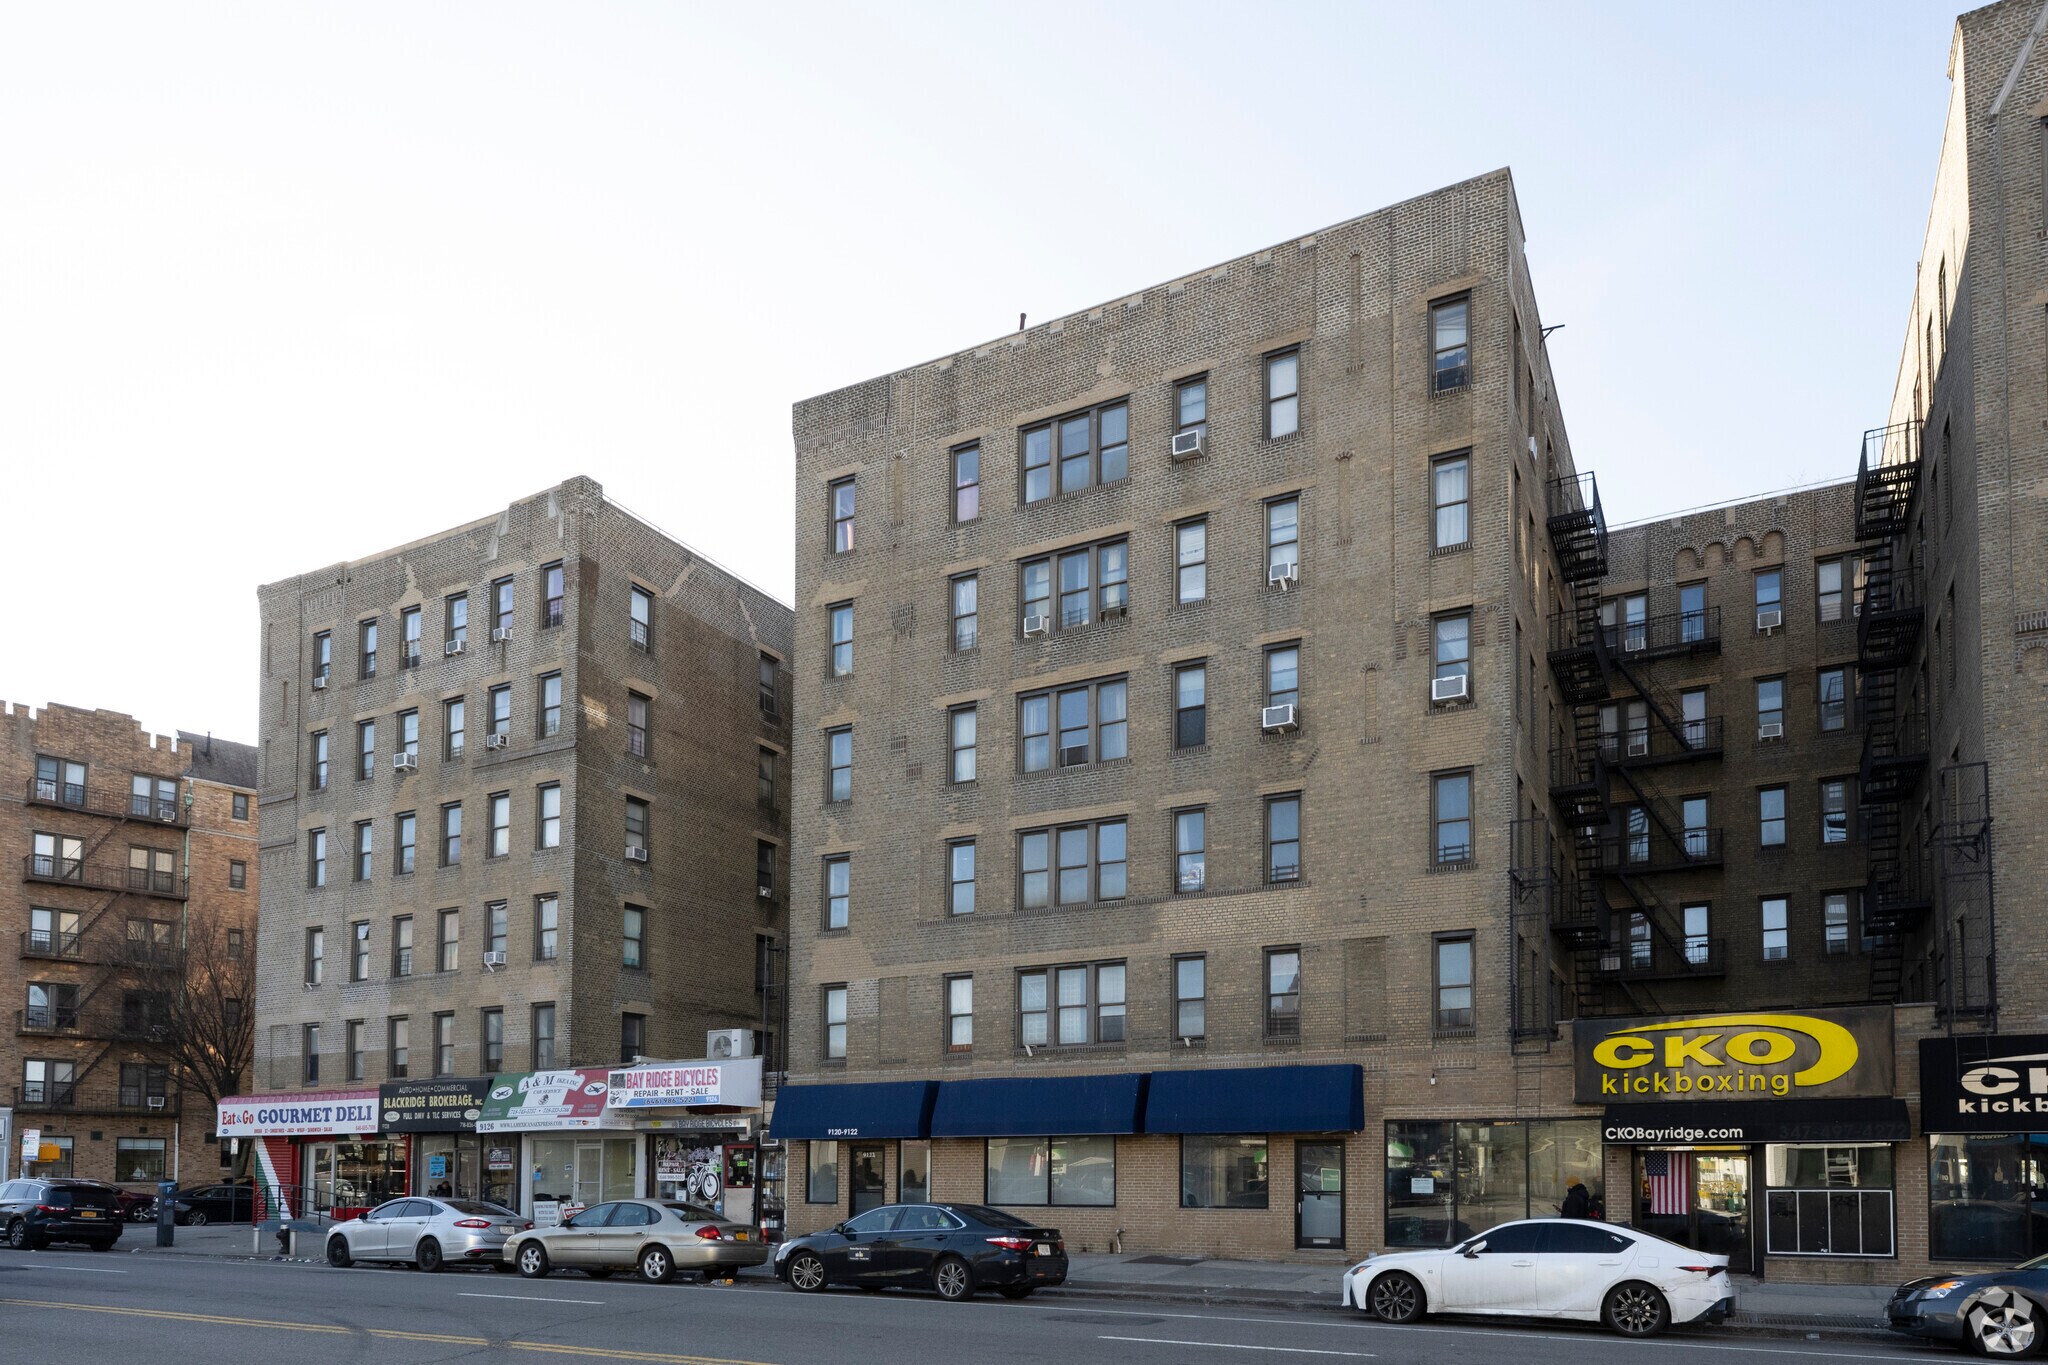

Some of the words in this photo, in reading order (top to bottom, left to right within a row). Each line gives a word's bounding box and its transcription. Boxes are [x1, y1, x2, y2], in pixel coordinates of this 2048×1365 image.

[1593, 1031, 1797, 1069] CKO
[522, 1082, 530, 1090] A
[532, 1078, 540, 1086] &
[542, 1075, 555, 1085] M
[626, 1072, 645, 1089] BAY
[645, 1071, 673, 1088] RIDGE
[674, 1068, 718, 1087] BICYCLES
[1602, 1069, 1789, 1097] kickboxing
[398, 1086, 412, 1094] AUTO
[415, 1085, 430, 1093] HOME
[433, 1084, 468, 1092] COMMERCIAL
[690, 1087, 709, 1095] SALE
[383, 1096, 426, 1109] BLACKRIDGE
[222, 1110, 236, 1126] Eat
[242, 1110, 254, 1125] Go
[258, 1106, 332, 1124] GOURMET
[335, 1105, 373, 1122] DELI
[402, 1112, 413, 1120] FULL
[432, 1111, 440, 1119] TLC
[441, 1111, 461, 1119] SERVICES
[479, 1122, 495, 1130] 9126
[827, 1128, 858, 1136] 9120-9122
[1605, 1126, 1744, 1143] CKOBayridge.com
